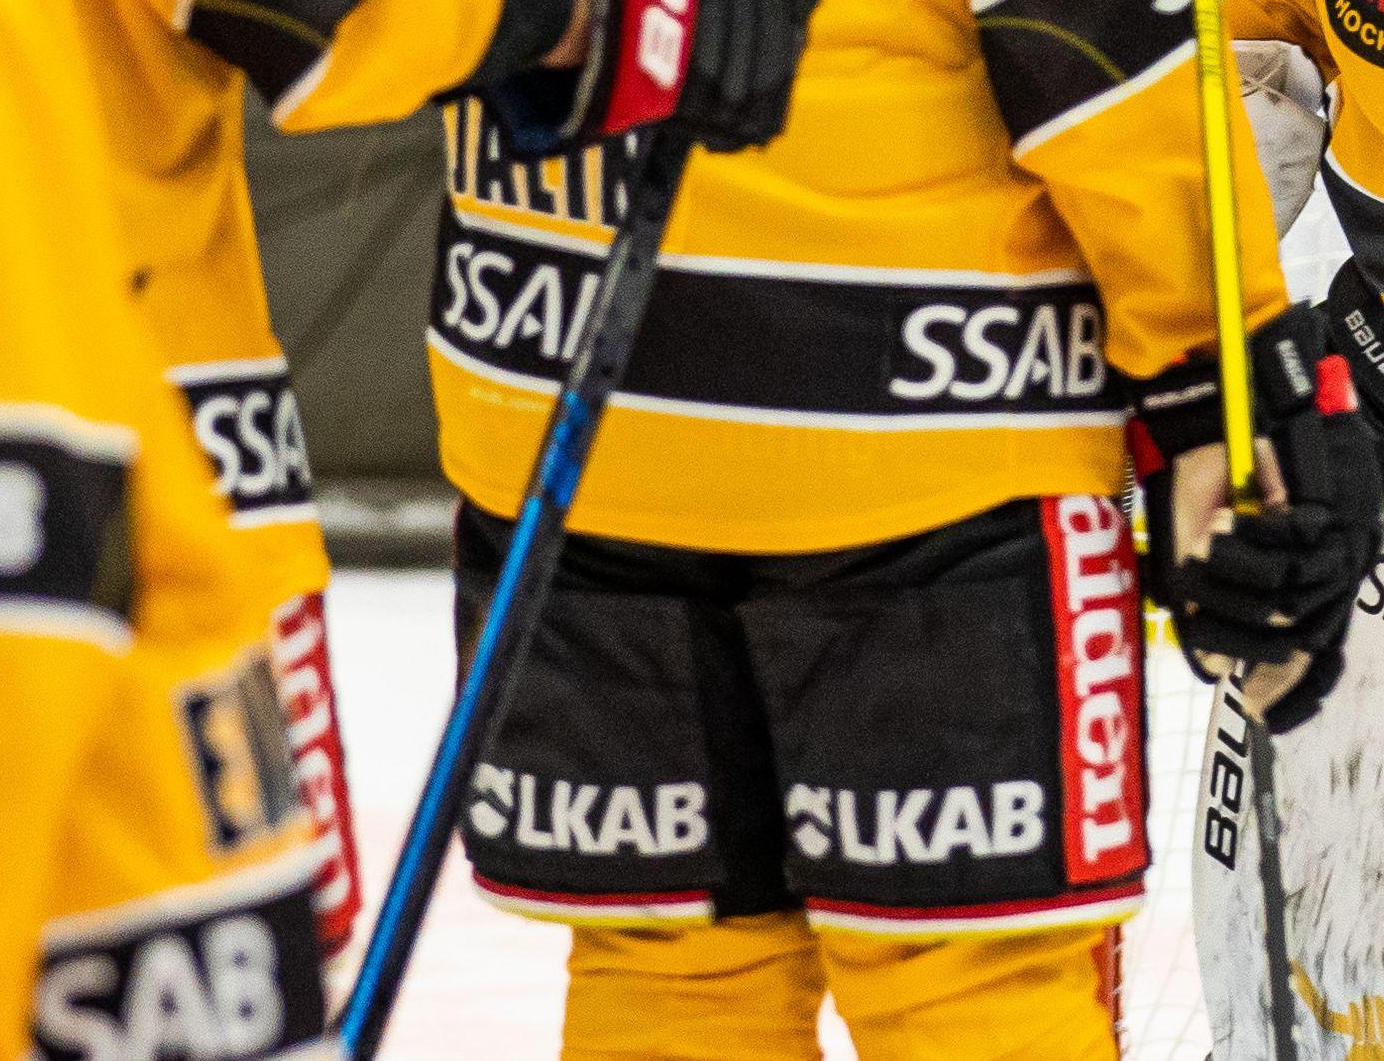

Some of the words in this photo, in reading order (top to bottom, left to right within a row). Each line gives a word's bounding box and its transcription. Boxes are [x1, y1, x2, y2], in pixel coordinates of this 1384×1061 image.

[889, 303, 1103, 401] SSAB
[193, 391, 312, 499] SSA
[516, 781, 708, 856] LKAB
[839, 781, 1046, 865] LKAB
